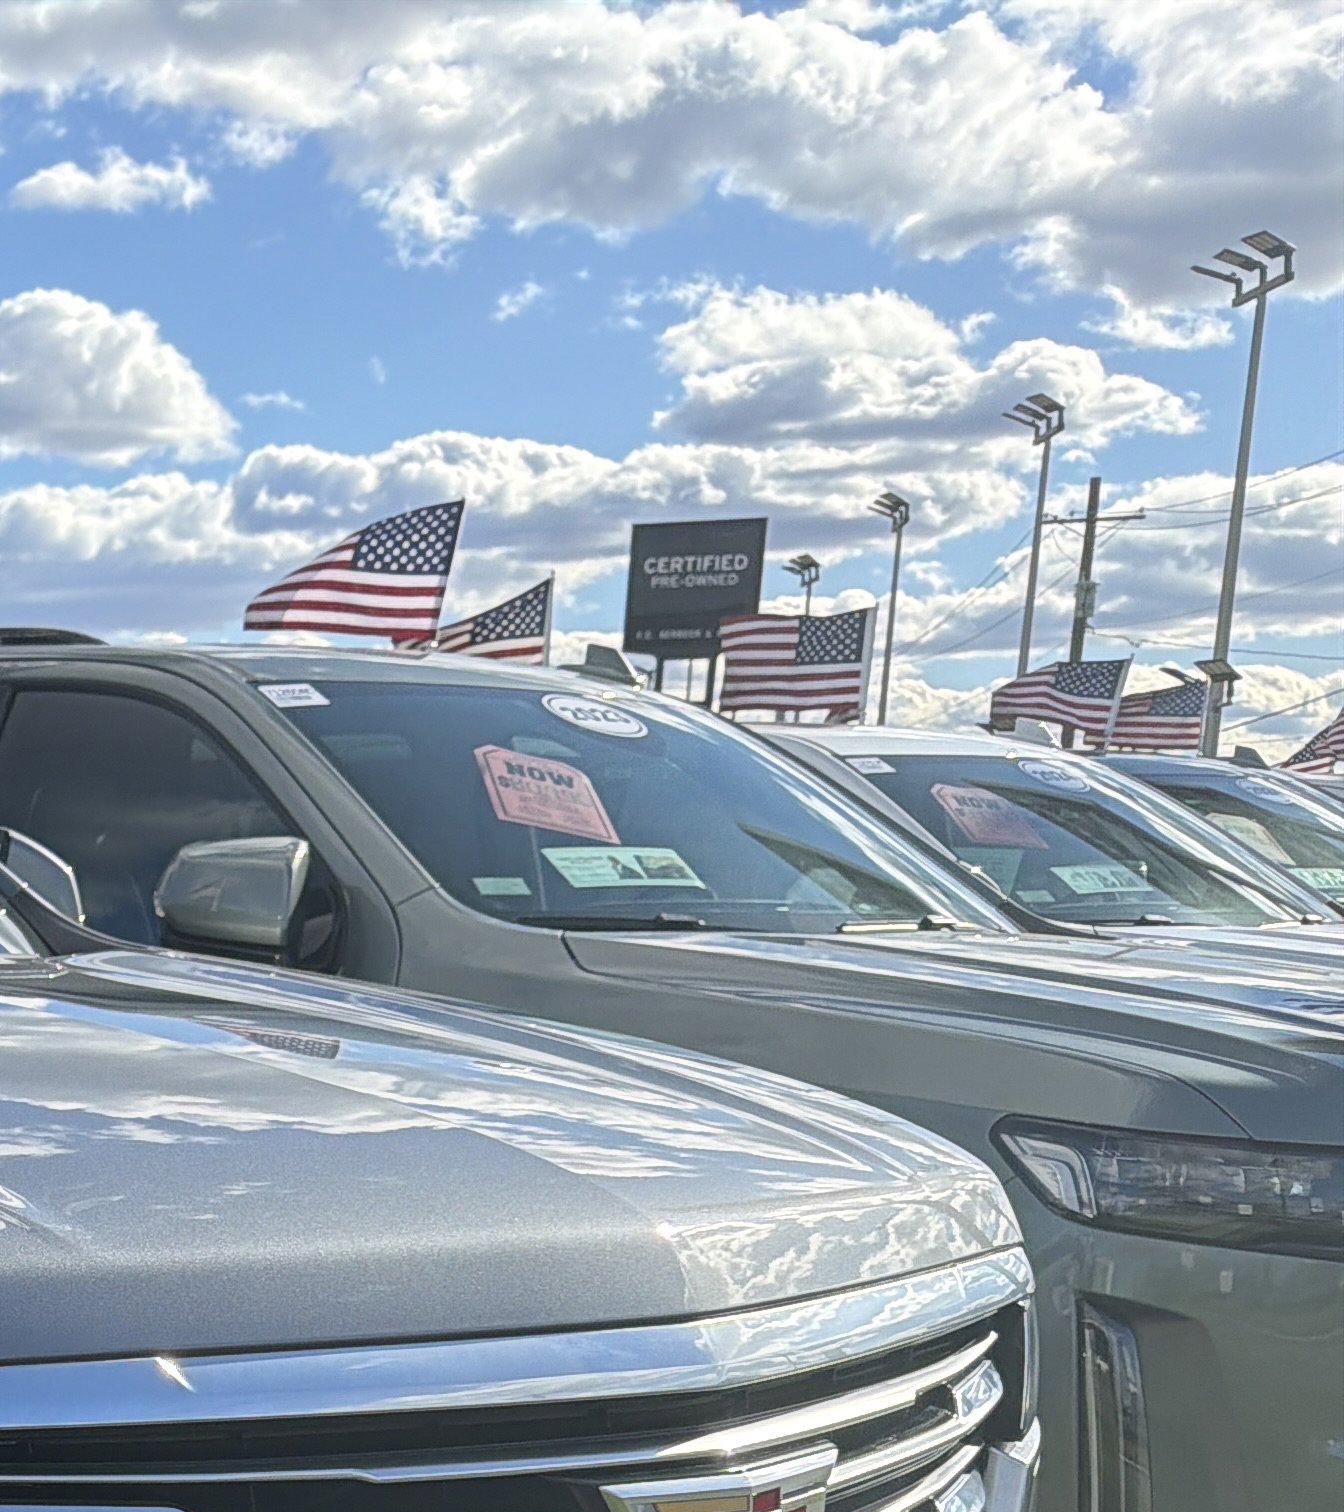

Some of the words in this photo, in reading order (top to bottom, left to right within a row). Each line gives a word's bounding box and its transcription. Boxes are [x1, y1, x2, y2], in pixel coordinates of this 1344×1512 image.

[643, 553, 749, 574] CERTIFIED
[650, 572, 739, 589] PRE-OWNED
[504, 759, 574, 789] NOW
